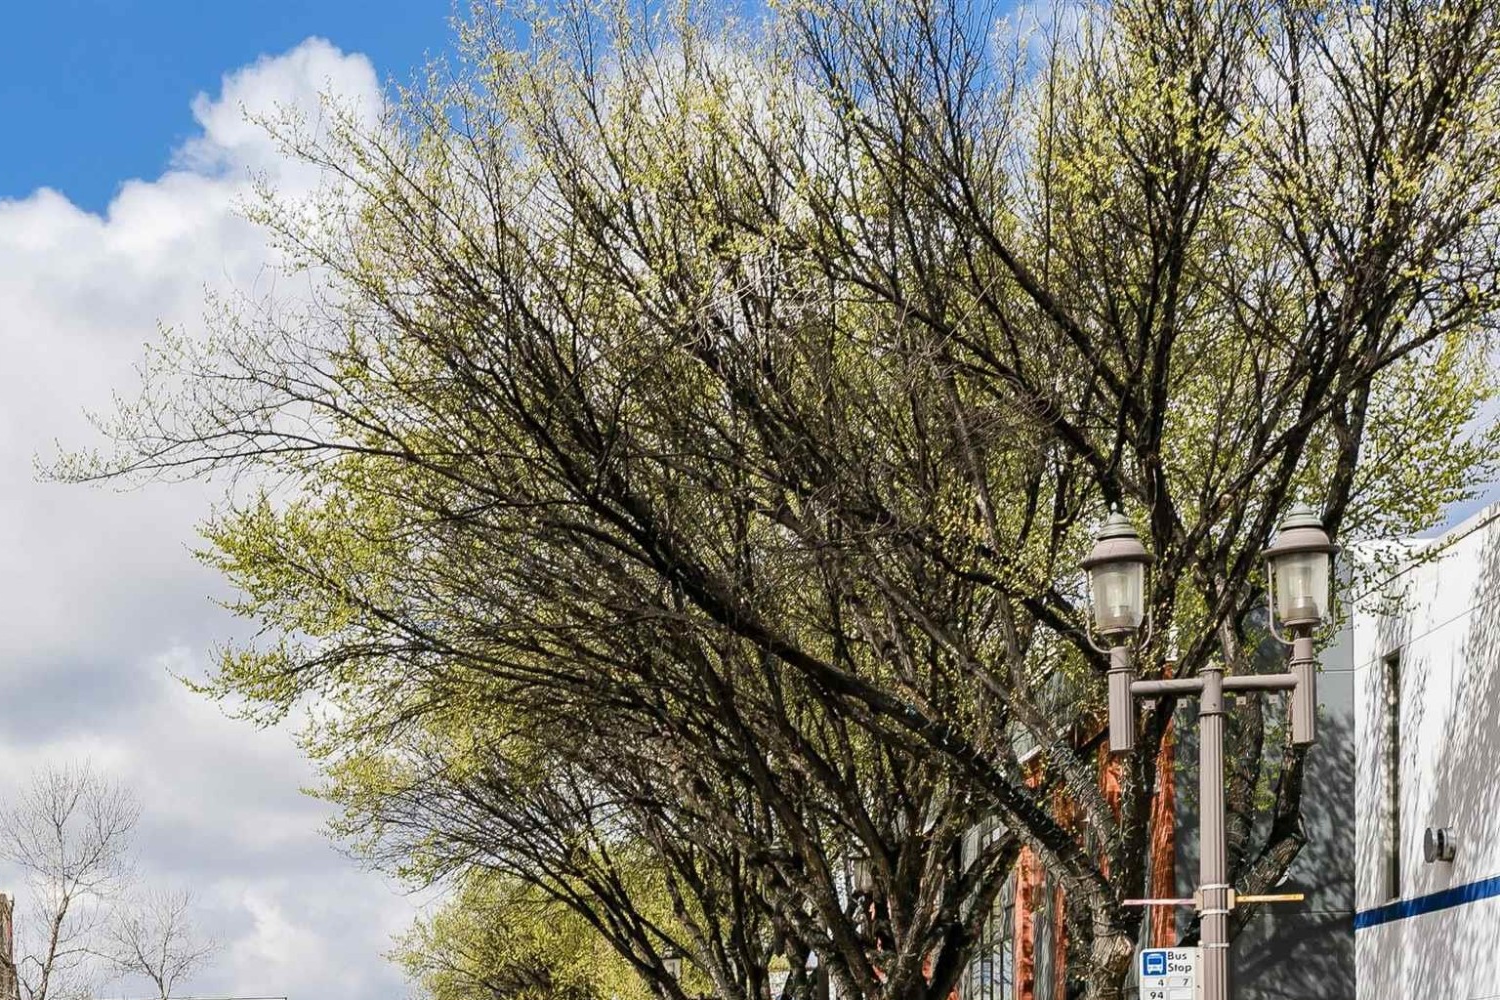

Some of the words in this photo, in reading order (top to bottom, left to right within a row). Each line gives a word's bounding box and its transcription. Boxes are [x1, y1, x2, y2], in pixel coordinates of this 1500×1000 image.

[1167, 951, 1188, 961] Bus
[1167, 963, 1193, 974] Stop
[1157, 979, 1165, 987] 4
[1182, 978, 1189, 987] 7
[1149, 991, 1165, 1000] 94
